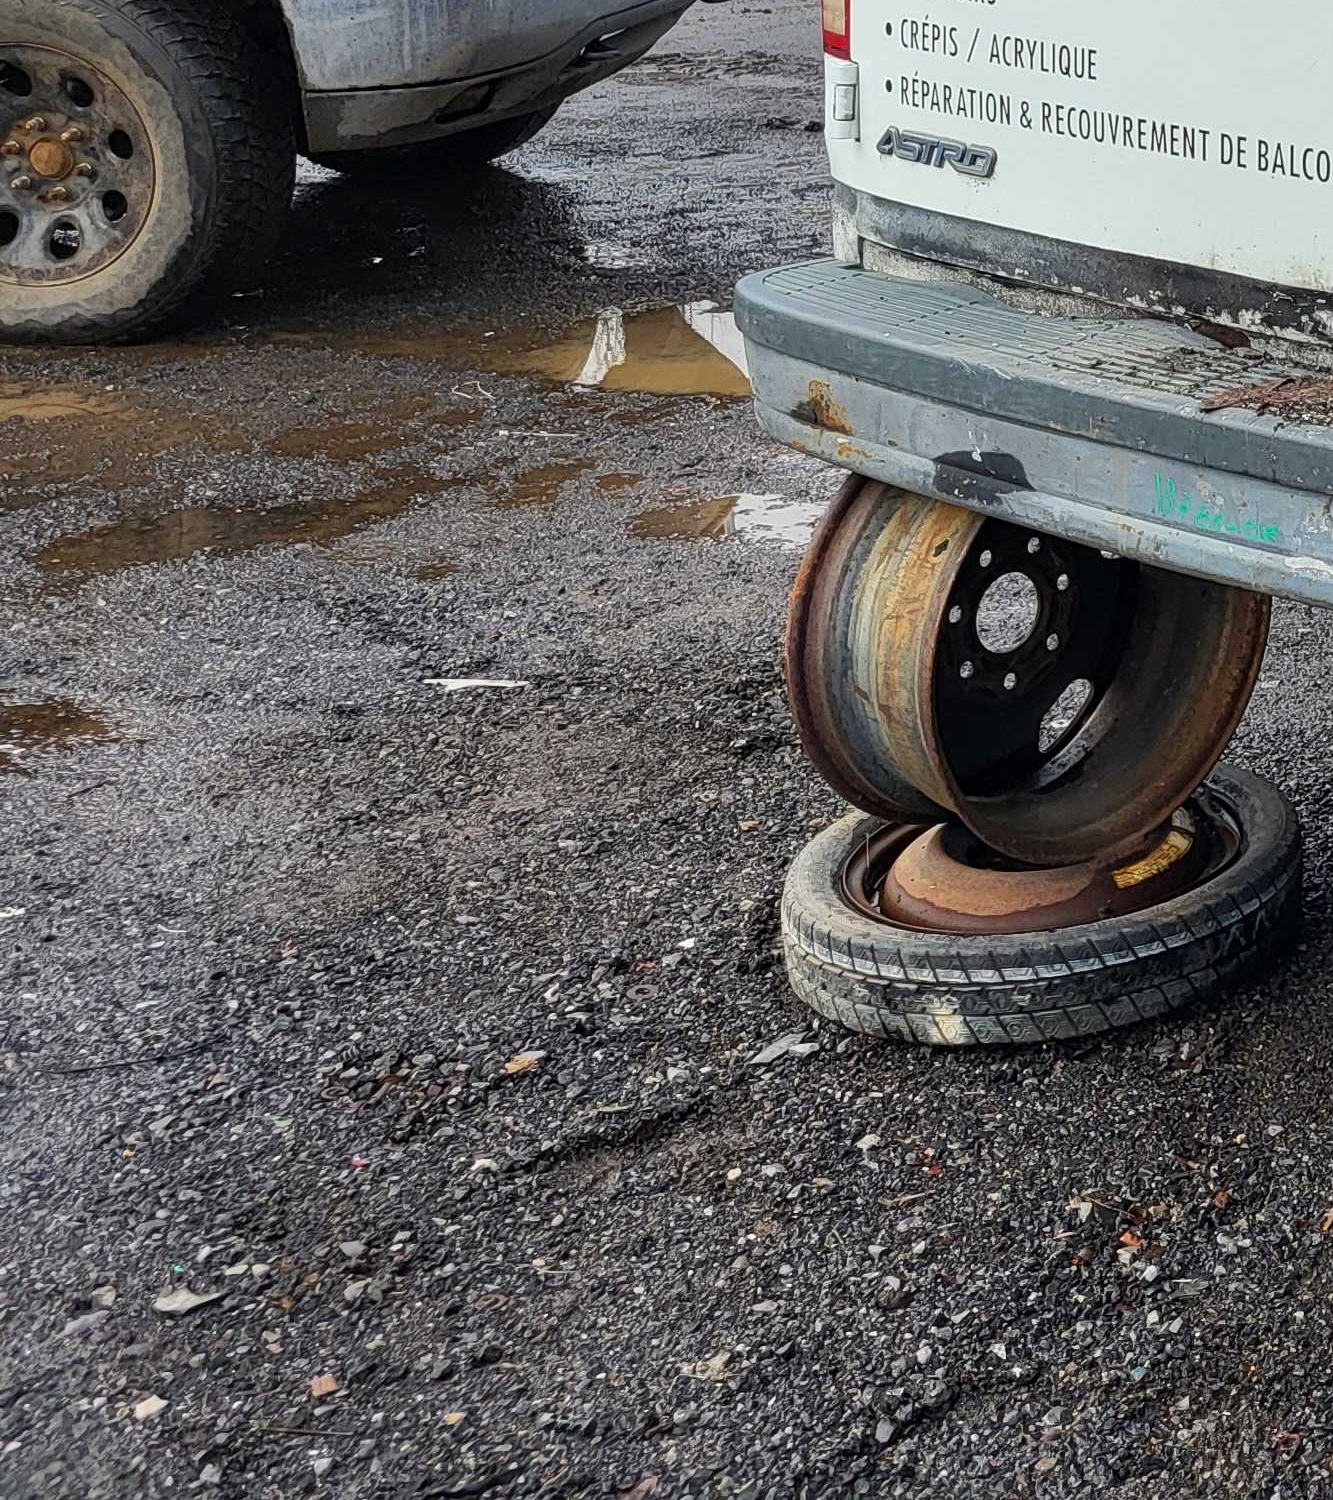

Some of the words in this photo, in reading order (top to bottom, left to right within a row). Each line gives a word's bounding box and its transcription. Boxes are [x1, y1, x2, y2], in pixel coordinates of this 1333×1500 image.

[900, 16, 959, 59] CRÉPIS
[989, 33, 1098, 82] ACRYLIQUE
[876, 125, 997, 178] ASTRO
[900, 73, 1012, 127] RÉPARATION
[1018, 100, 1033, 129] &
[1041, 103, 1209, 166] RECOUVREMENT
[1220, 134, 1248, 168] DE
